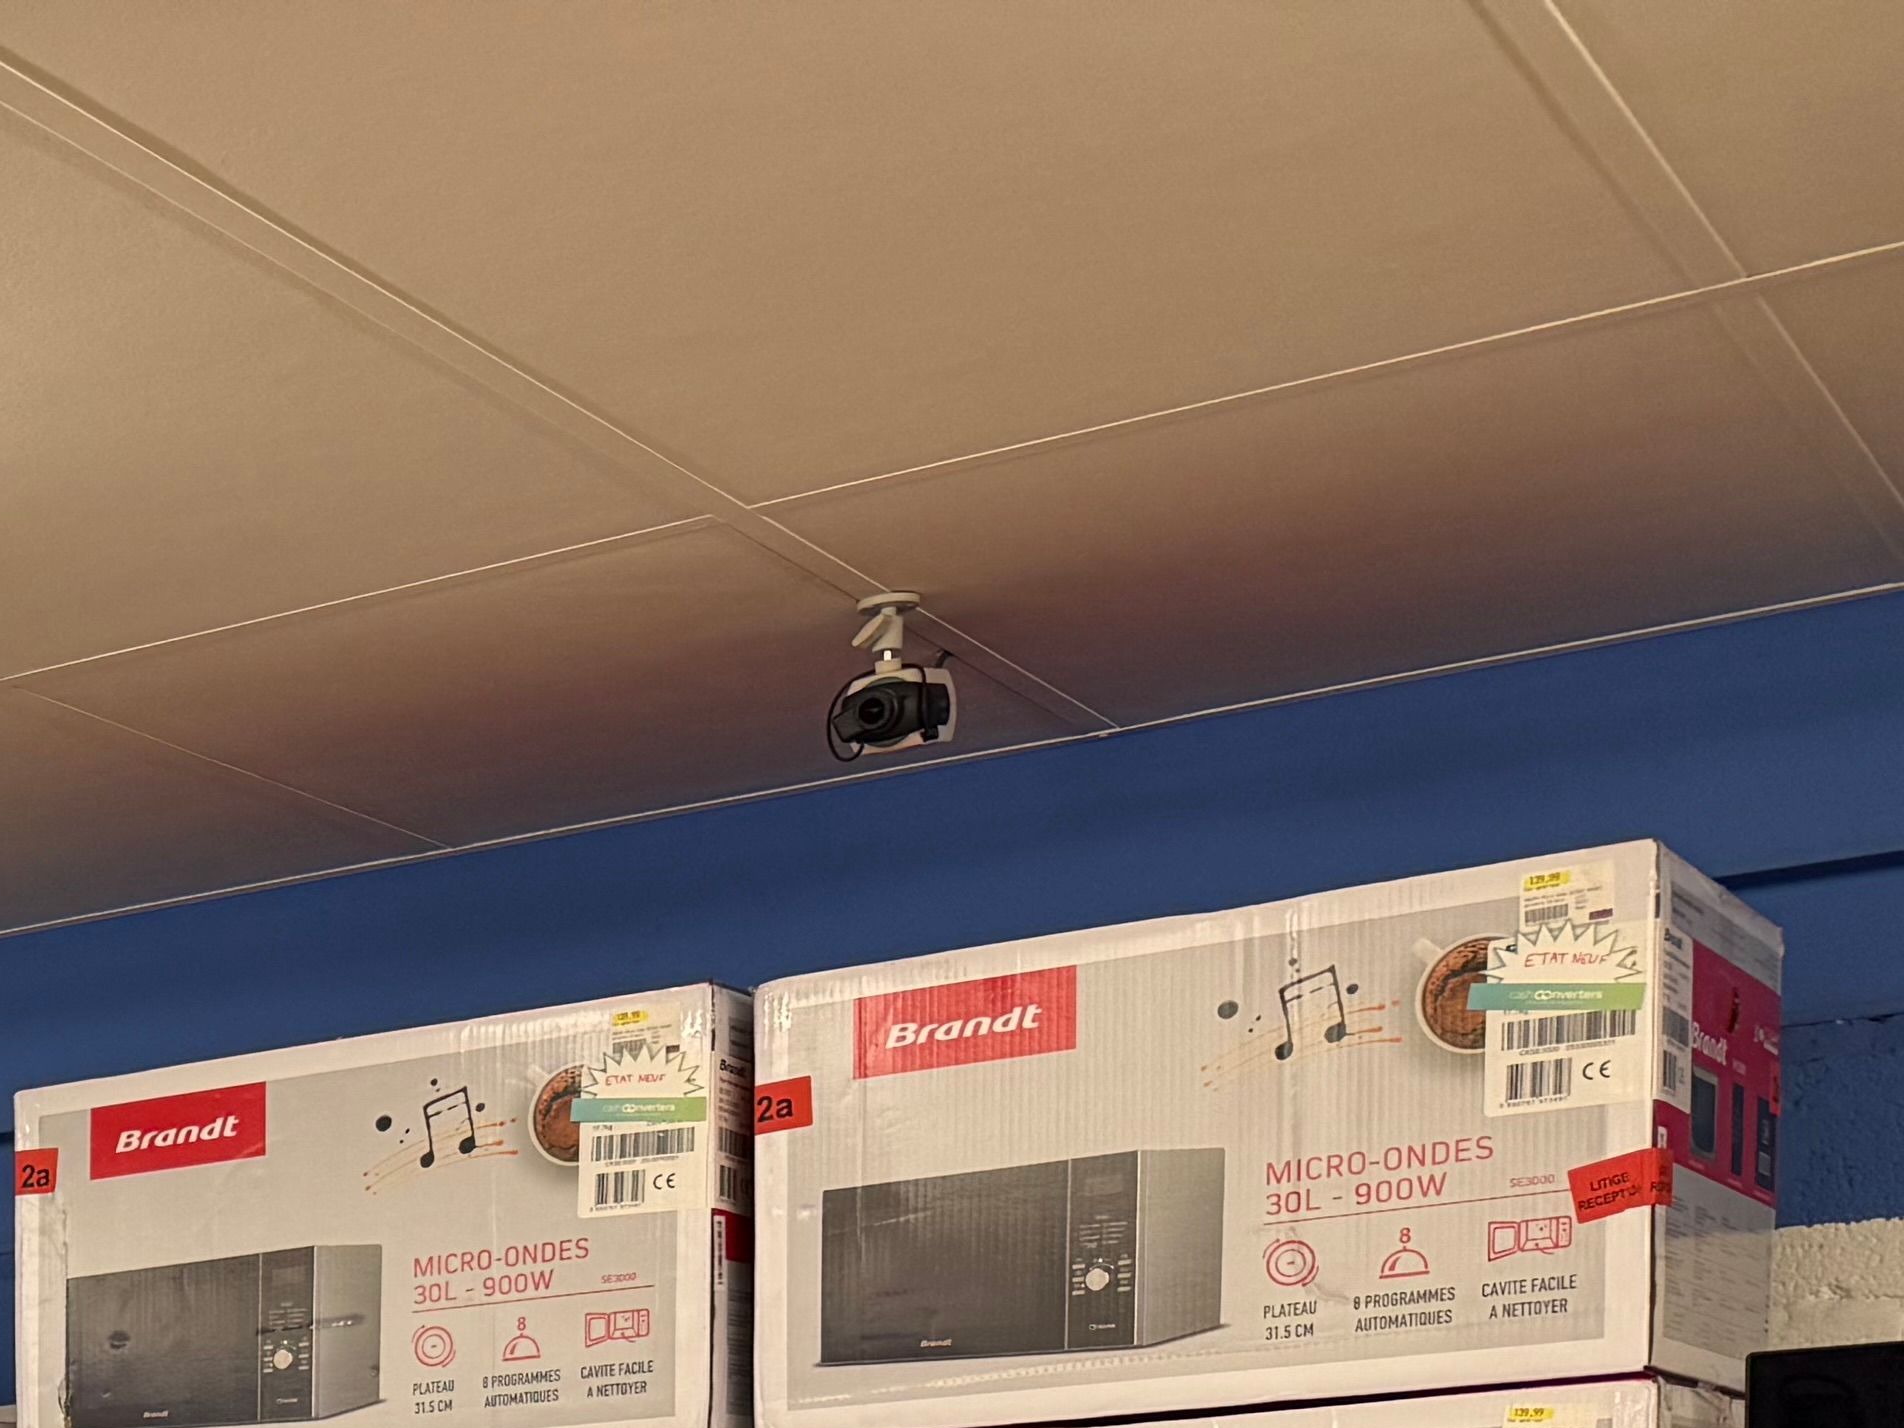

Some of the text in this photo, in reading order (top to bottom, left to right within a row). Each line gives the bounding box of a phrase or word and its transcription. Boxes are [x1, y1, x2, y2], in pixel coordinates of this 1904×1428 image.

[885, 1000, 1043, 1049] Brandt
[757, 1092, 794, 1122] 2a
[115, 1113, 240, 1153] Brandt
[20, 1162, 50, 1190] 2a
[1265, 1135, 1495, 1187] MICRO-ONDES
[1265, 1173, 1448, 1215] 30L 900W
[1589, 1171, 1630, 1195] LITIGE
[412, 1238, 590, 1278] MICRO-ONDES
